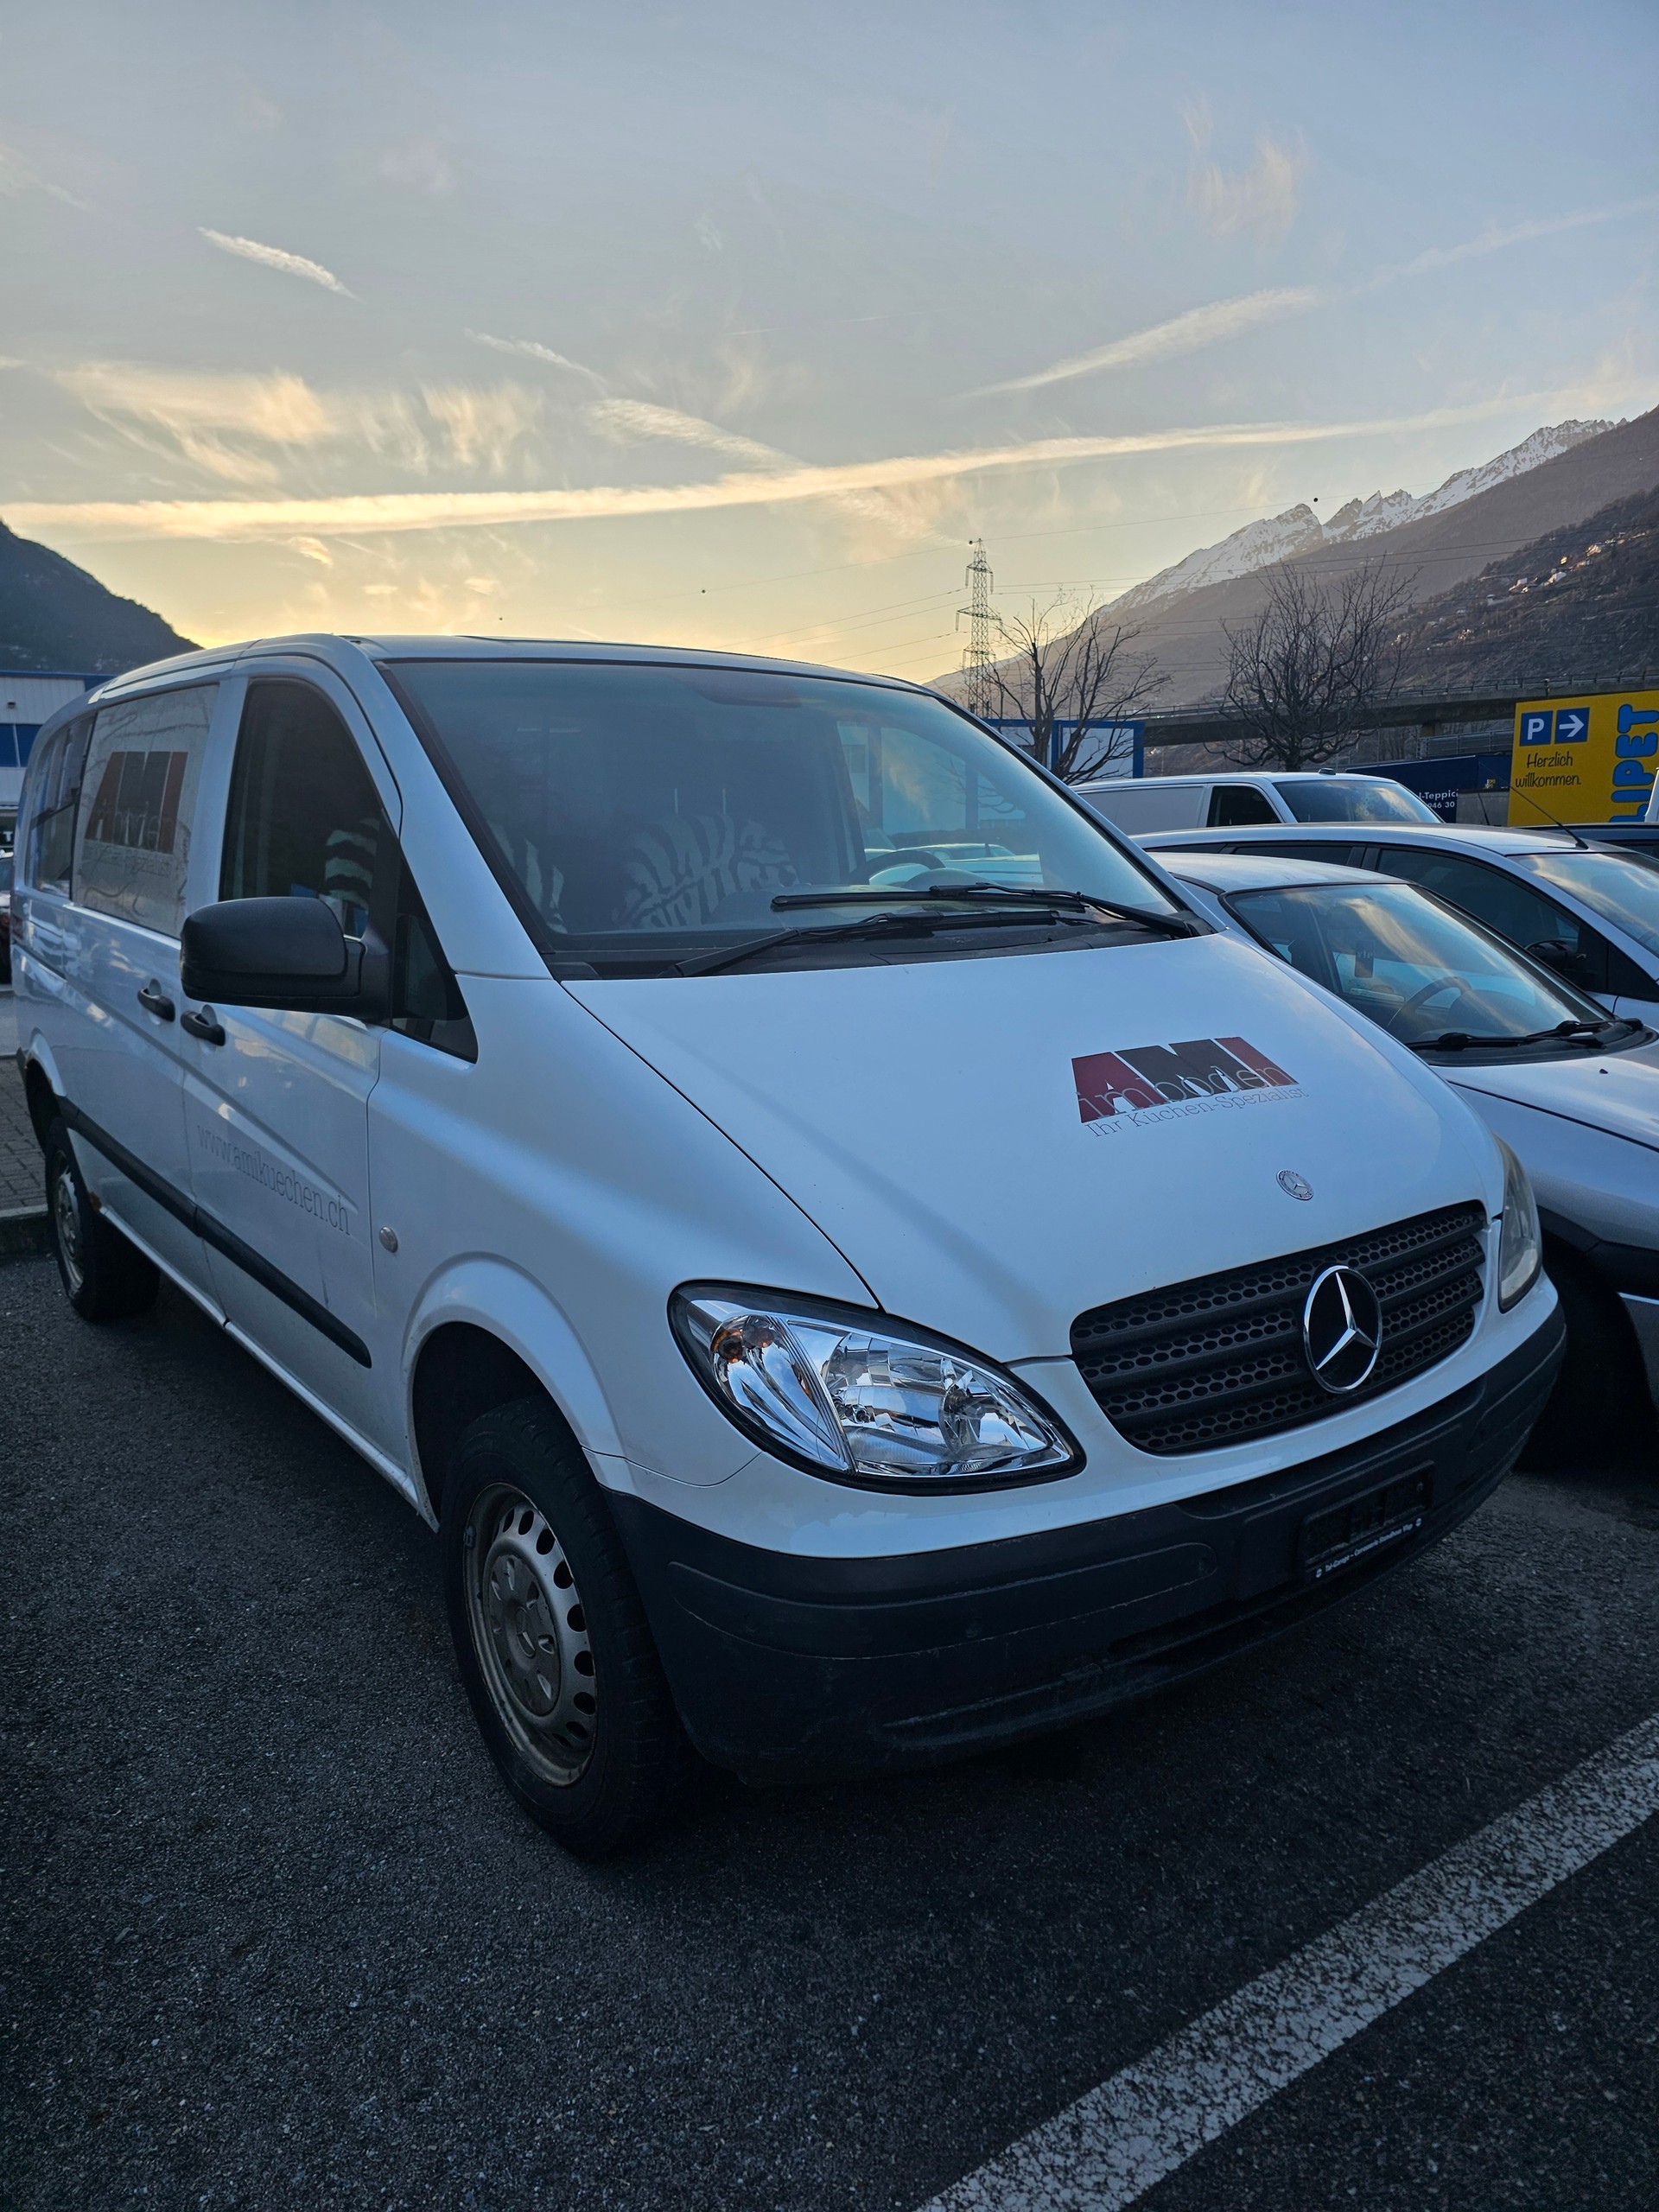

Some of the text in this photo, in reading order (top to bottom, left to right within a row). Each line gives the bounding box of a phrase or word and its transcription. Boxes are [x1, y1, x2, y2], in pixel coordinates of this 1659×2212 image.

[1527, 718, 1545, 741] P
[1527, 751, 1573, 768] Herzlich
[1515, 772, 1582, 788] willkommen.
[1071, 1036, 1300, 1123] AMI
[1084, 1120, 1122, 1137] Ihr
[196, 1125, 351, 1236] www.amikuechen.ch
